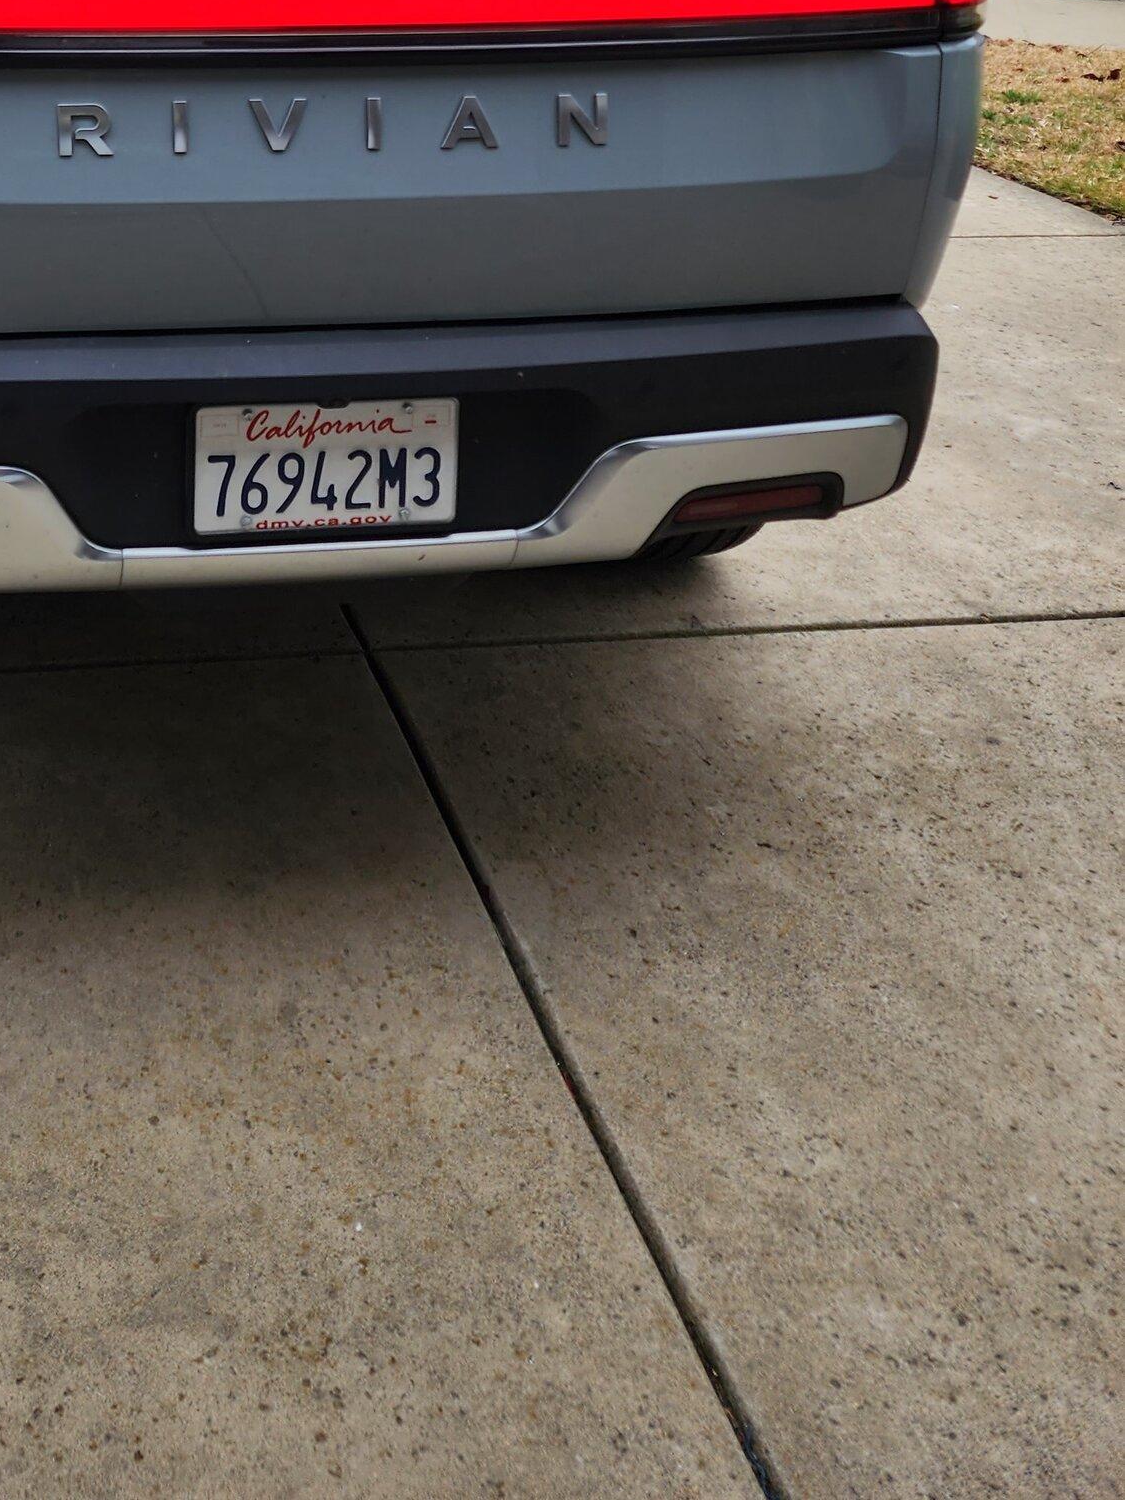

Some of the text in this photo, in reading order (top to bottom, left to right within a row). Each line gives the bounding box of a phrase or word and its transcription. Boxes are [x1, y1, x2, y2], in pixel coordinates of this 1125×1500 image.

[57, 92, 608, 158] RIVIAN
[245, 408, 413, 449] California
[207, 446, 442, 517] 76942M3
[255, 514, 393, 531] dmv.ca.gov
